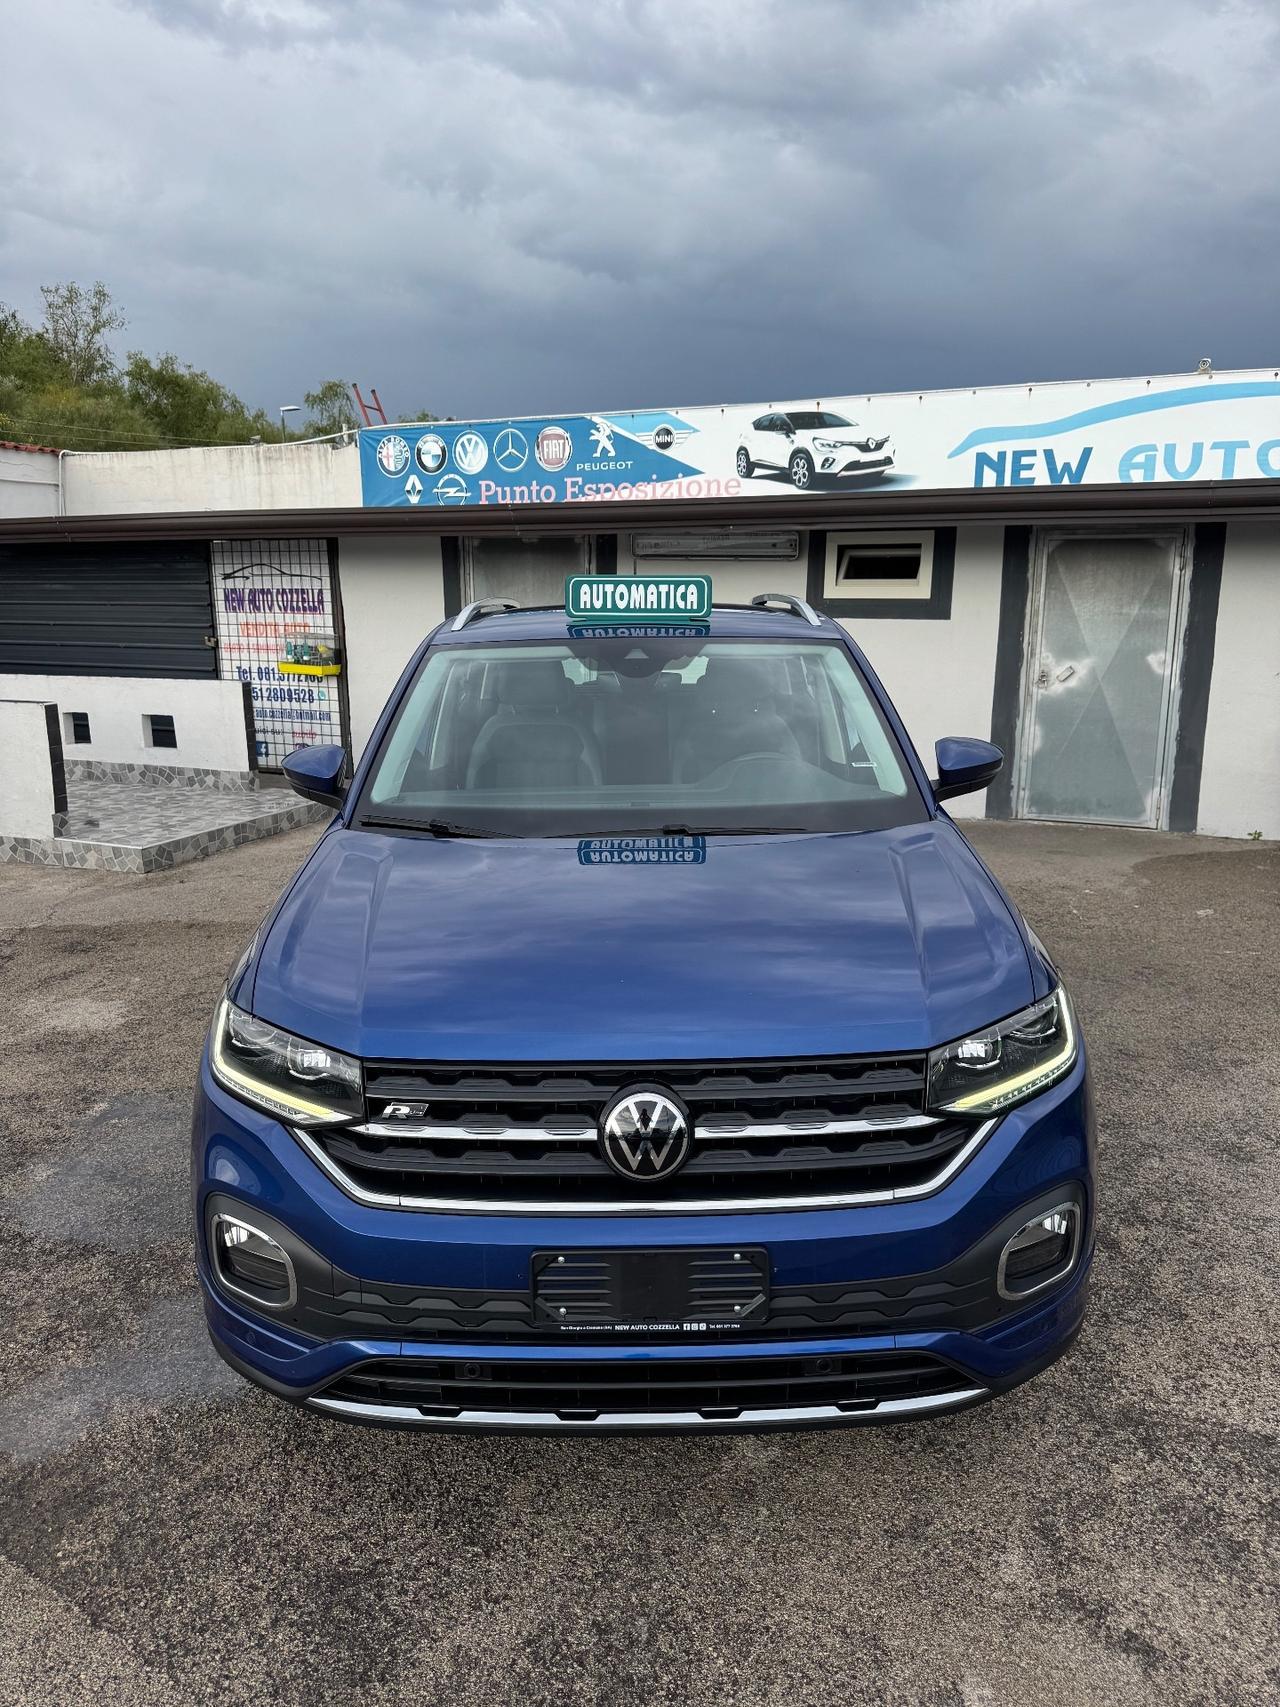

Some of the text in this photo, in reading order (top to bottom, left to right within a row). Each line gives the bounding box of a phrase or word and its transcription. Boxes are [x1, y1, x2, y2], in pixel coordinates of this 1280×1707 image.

[543, 439, 564, 460] FIAT
[655, 434, 674, 443] MINI
[576, 461, 633, 471] PEUGEOT
[974, 446, 1094, 488] NEW
[479, 473, 741, 504] Punto Esposizione
[223, 588, 325, 615] NEW AUTO COZZELLA
[579, 583, 698, 610] AUTOMATICA
[236, 666, 256, 681] Tel.
